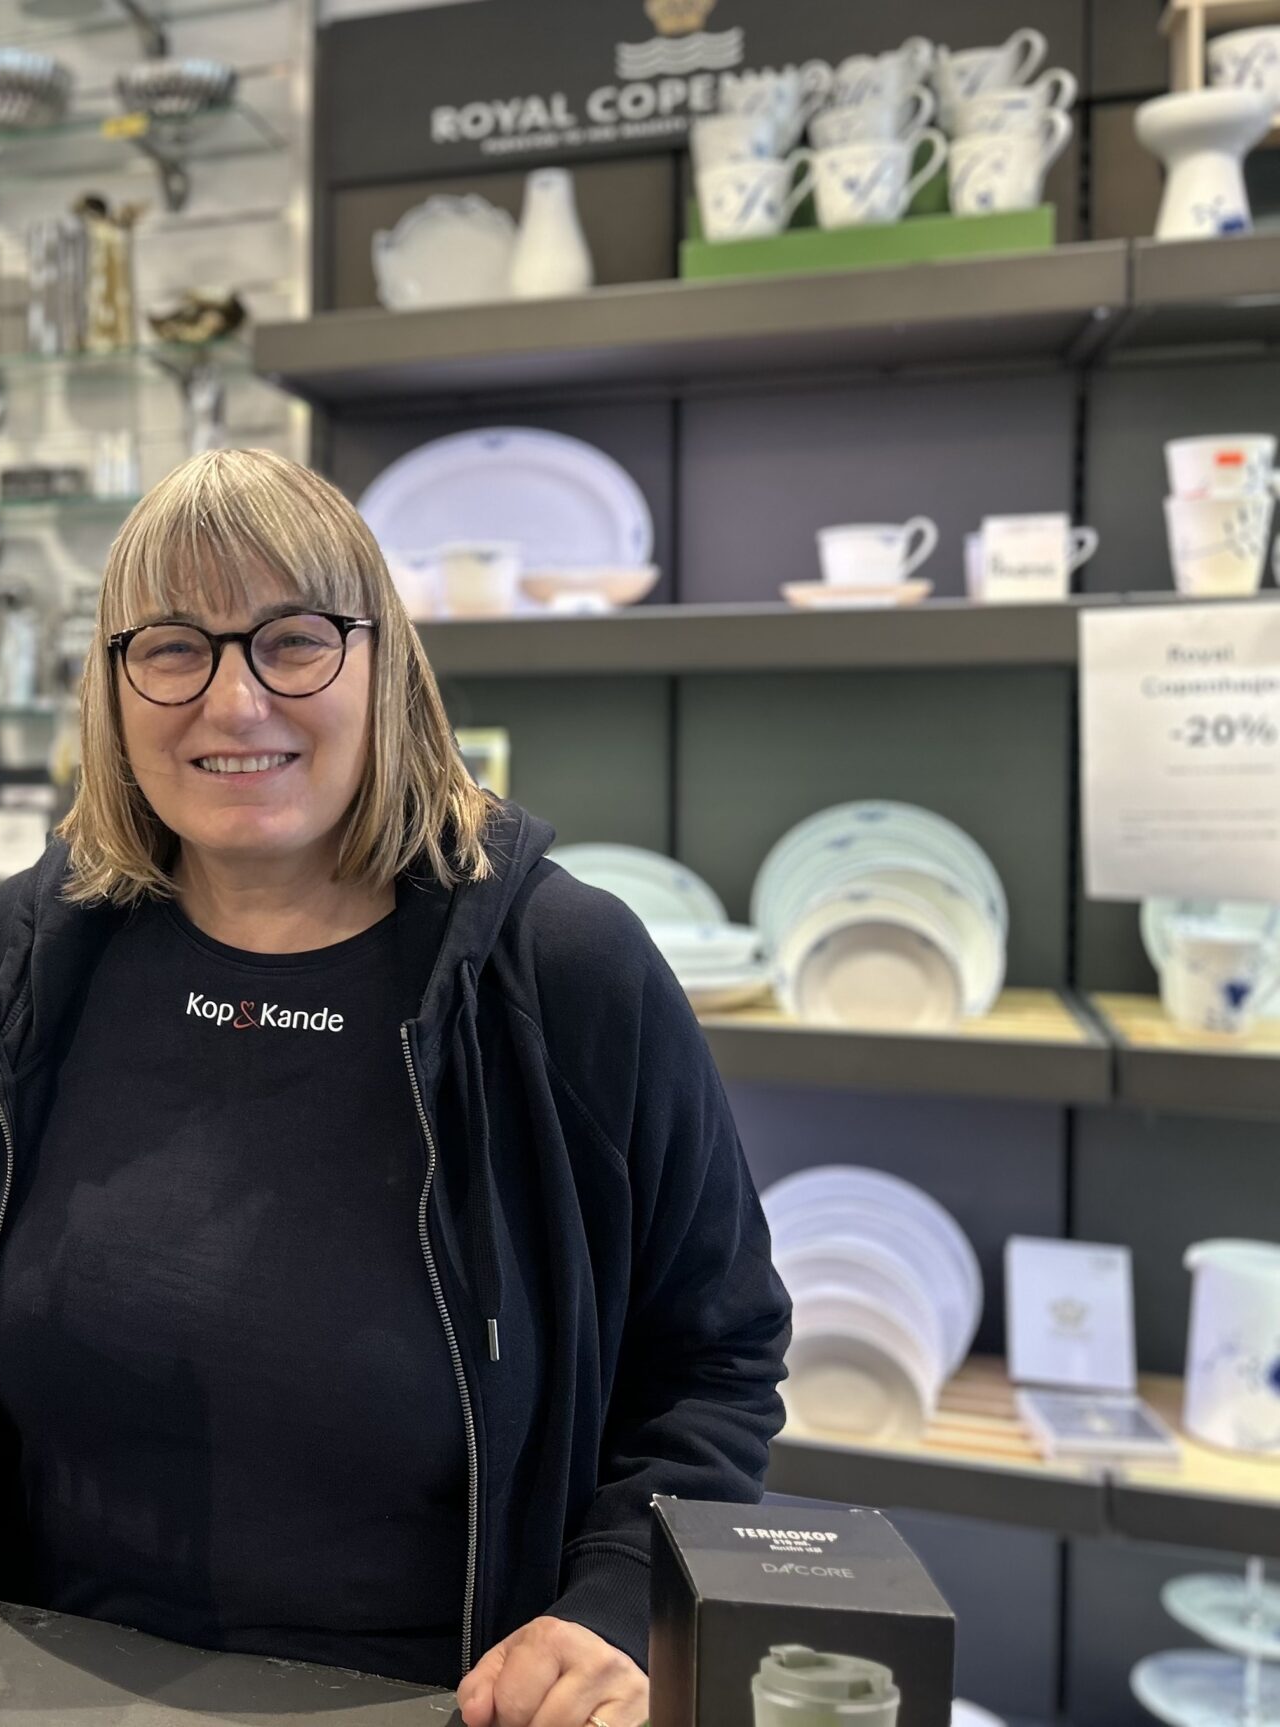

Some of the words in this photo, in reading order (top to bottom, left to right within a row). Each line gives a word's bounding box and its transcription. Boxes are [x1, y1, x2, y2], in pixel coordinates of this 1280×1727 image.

[430, 93, 575, 142] ROYAL
[1141, 675, 1280, 698] Copenhage
[1171, 715, 1277, 746] -20%
[732, 1527, 839, 1543] TERMOKOP
